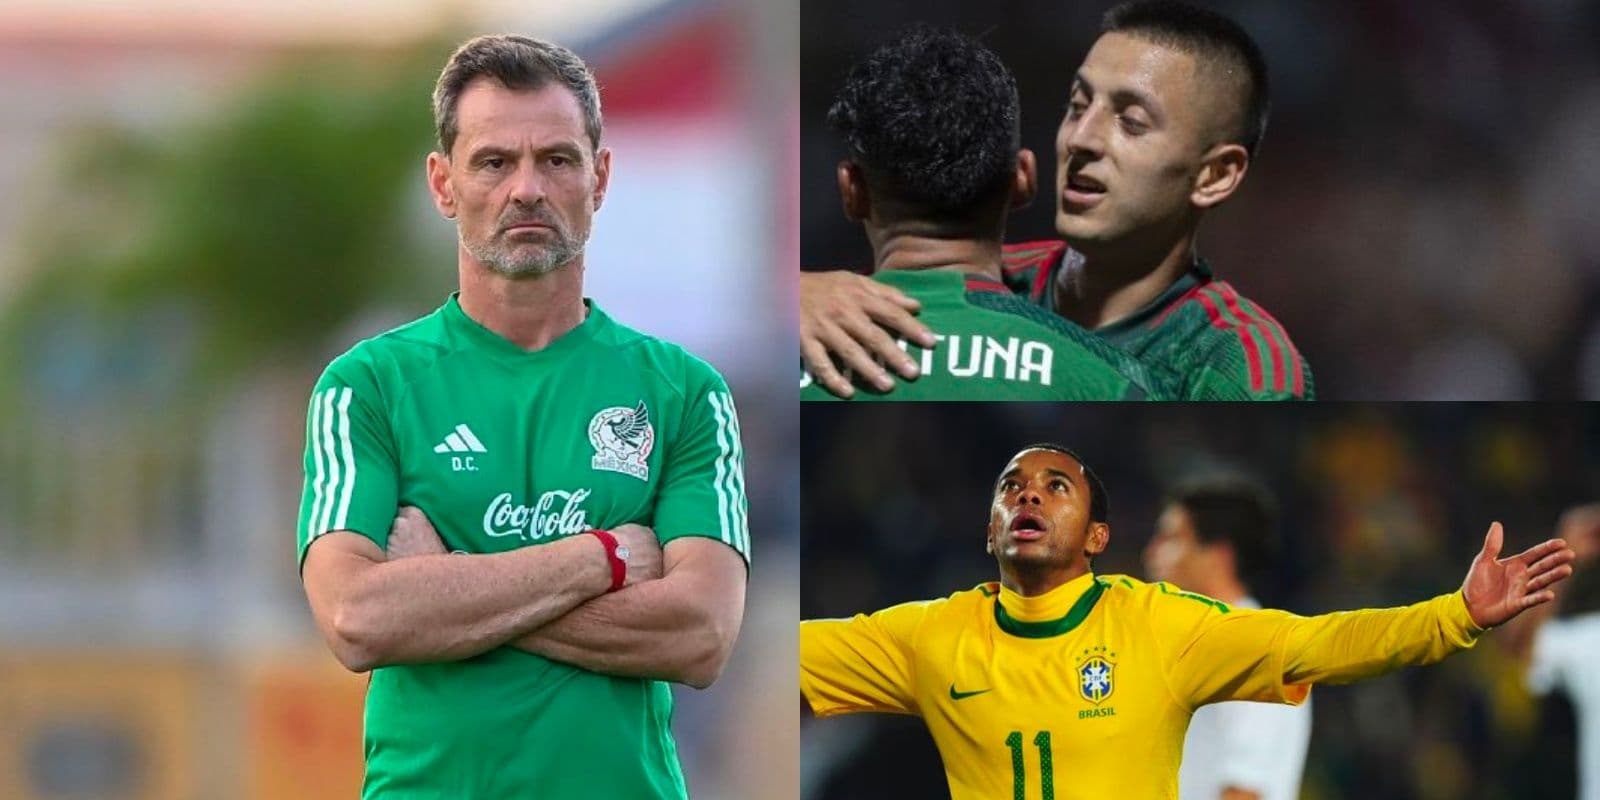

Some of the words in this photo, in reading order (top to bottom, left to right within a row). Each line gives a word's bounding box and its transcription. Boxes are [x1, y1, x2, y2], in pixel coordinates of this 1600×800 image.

[896, 335, 1054, 386] TUNA
[452, 456, 479, 471] D.C.
[1079, 707, 1116, 720] BRASIL
[1005, 731, 1055, 800] 11
